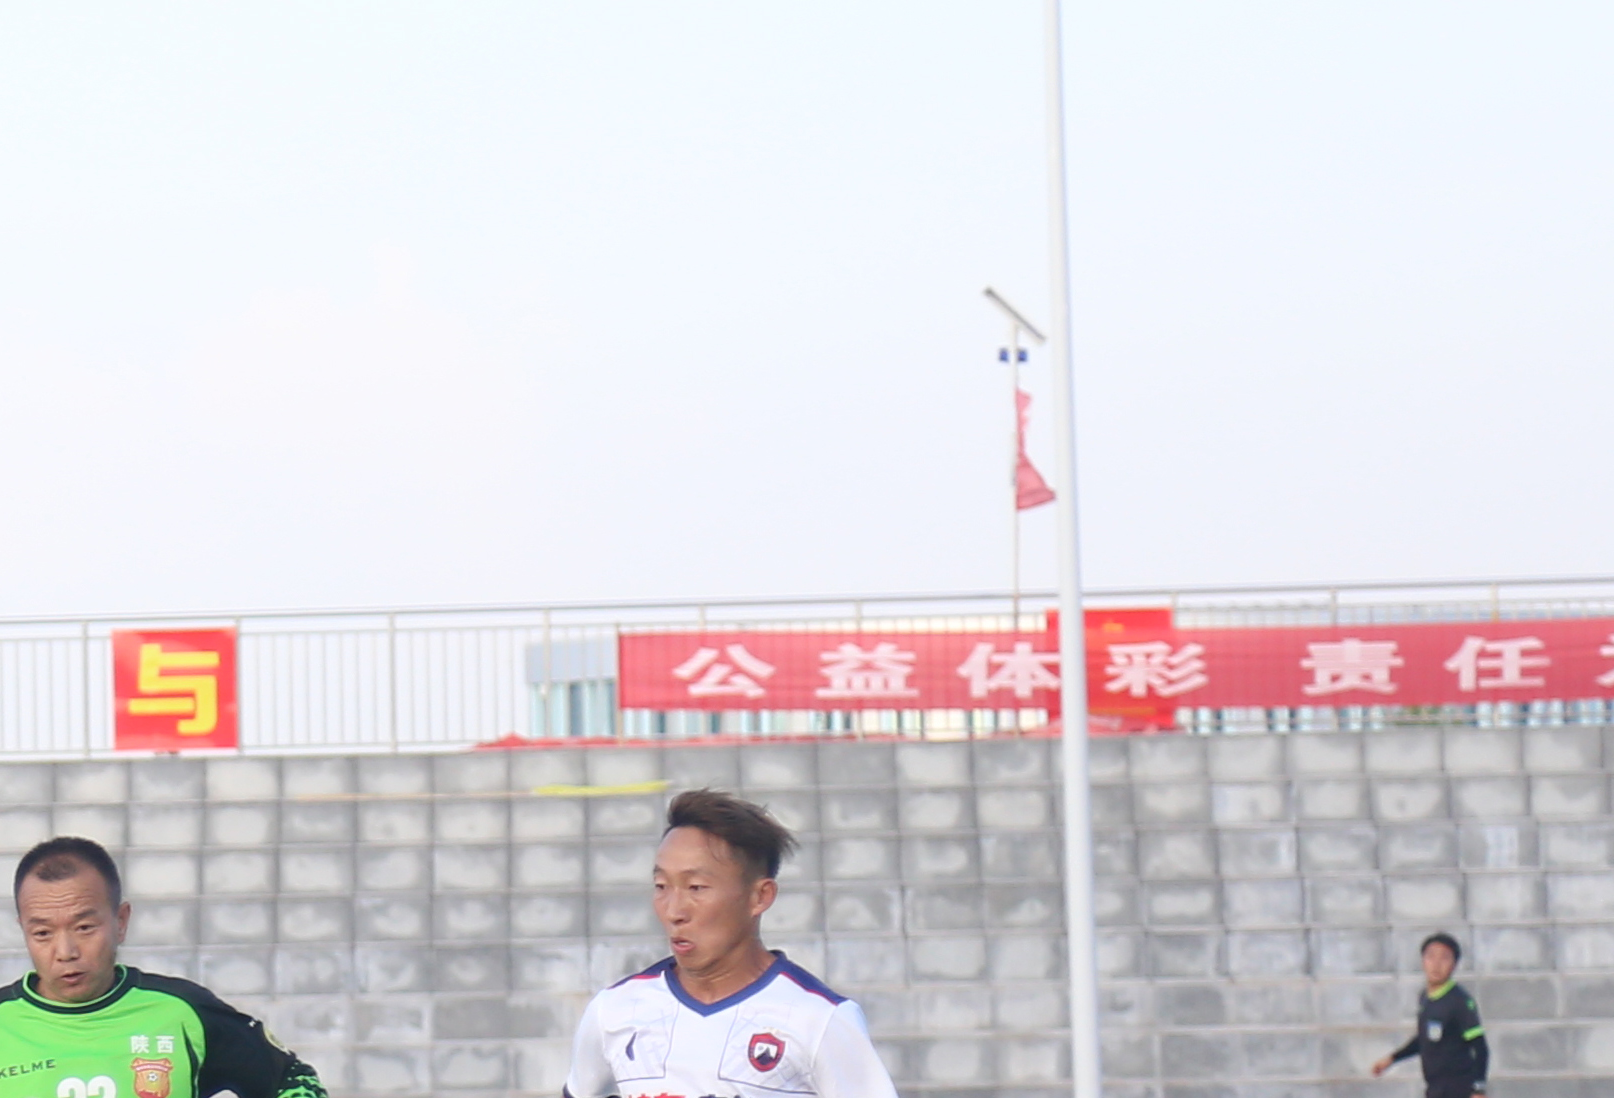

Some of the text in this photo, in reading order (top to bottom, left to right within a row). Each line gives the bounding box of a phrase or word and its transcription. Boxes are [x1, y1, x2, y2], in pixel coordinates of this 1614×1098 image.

[128, 643, 220, 735] 与
[672, 638, 1209, 698] 公益体彩
[1299, 634, 1614, 694] 责任
[130, 1034, 175, 1054] 陕西
